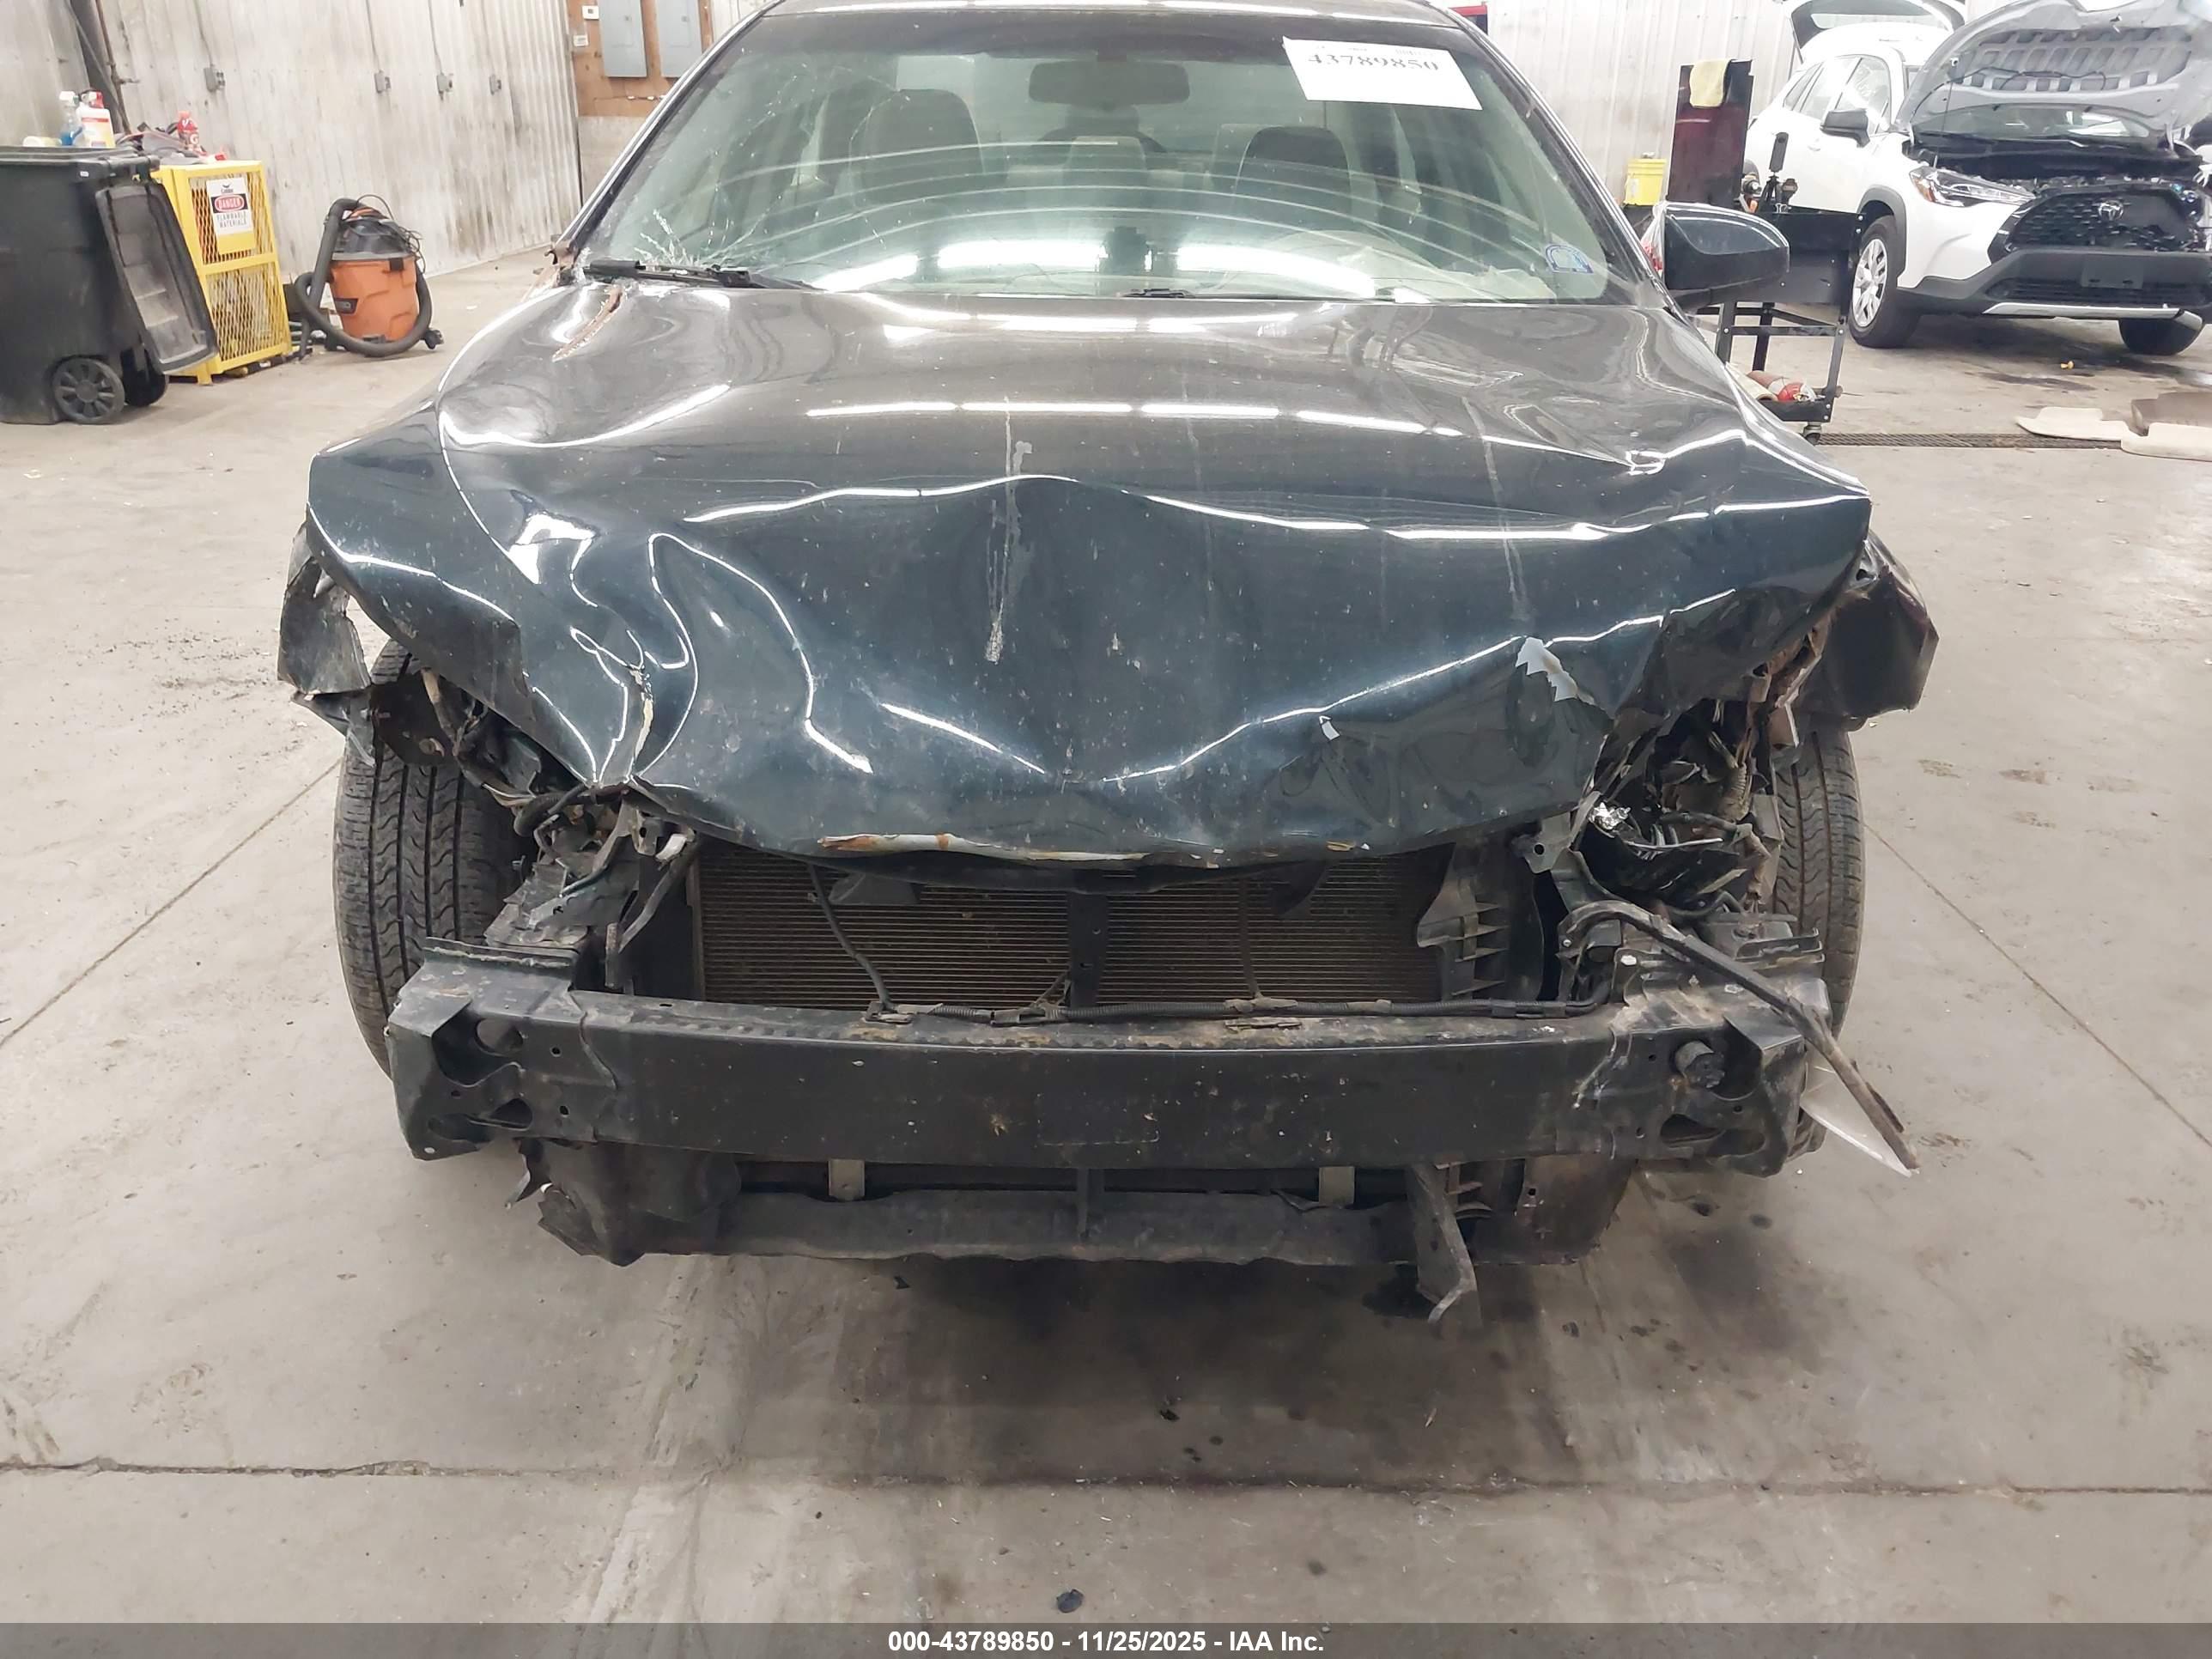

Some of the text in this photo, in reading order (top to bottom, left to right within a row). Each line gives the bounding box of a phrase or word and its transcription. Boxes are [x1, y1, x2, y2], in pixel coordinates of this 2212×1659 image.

[1308, 53, 1439, 71] 43789850
[217, 197, 242, 210] DANGER
[219, 219, 247, 228] MATERIALS
